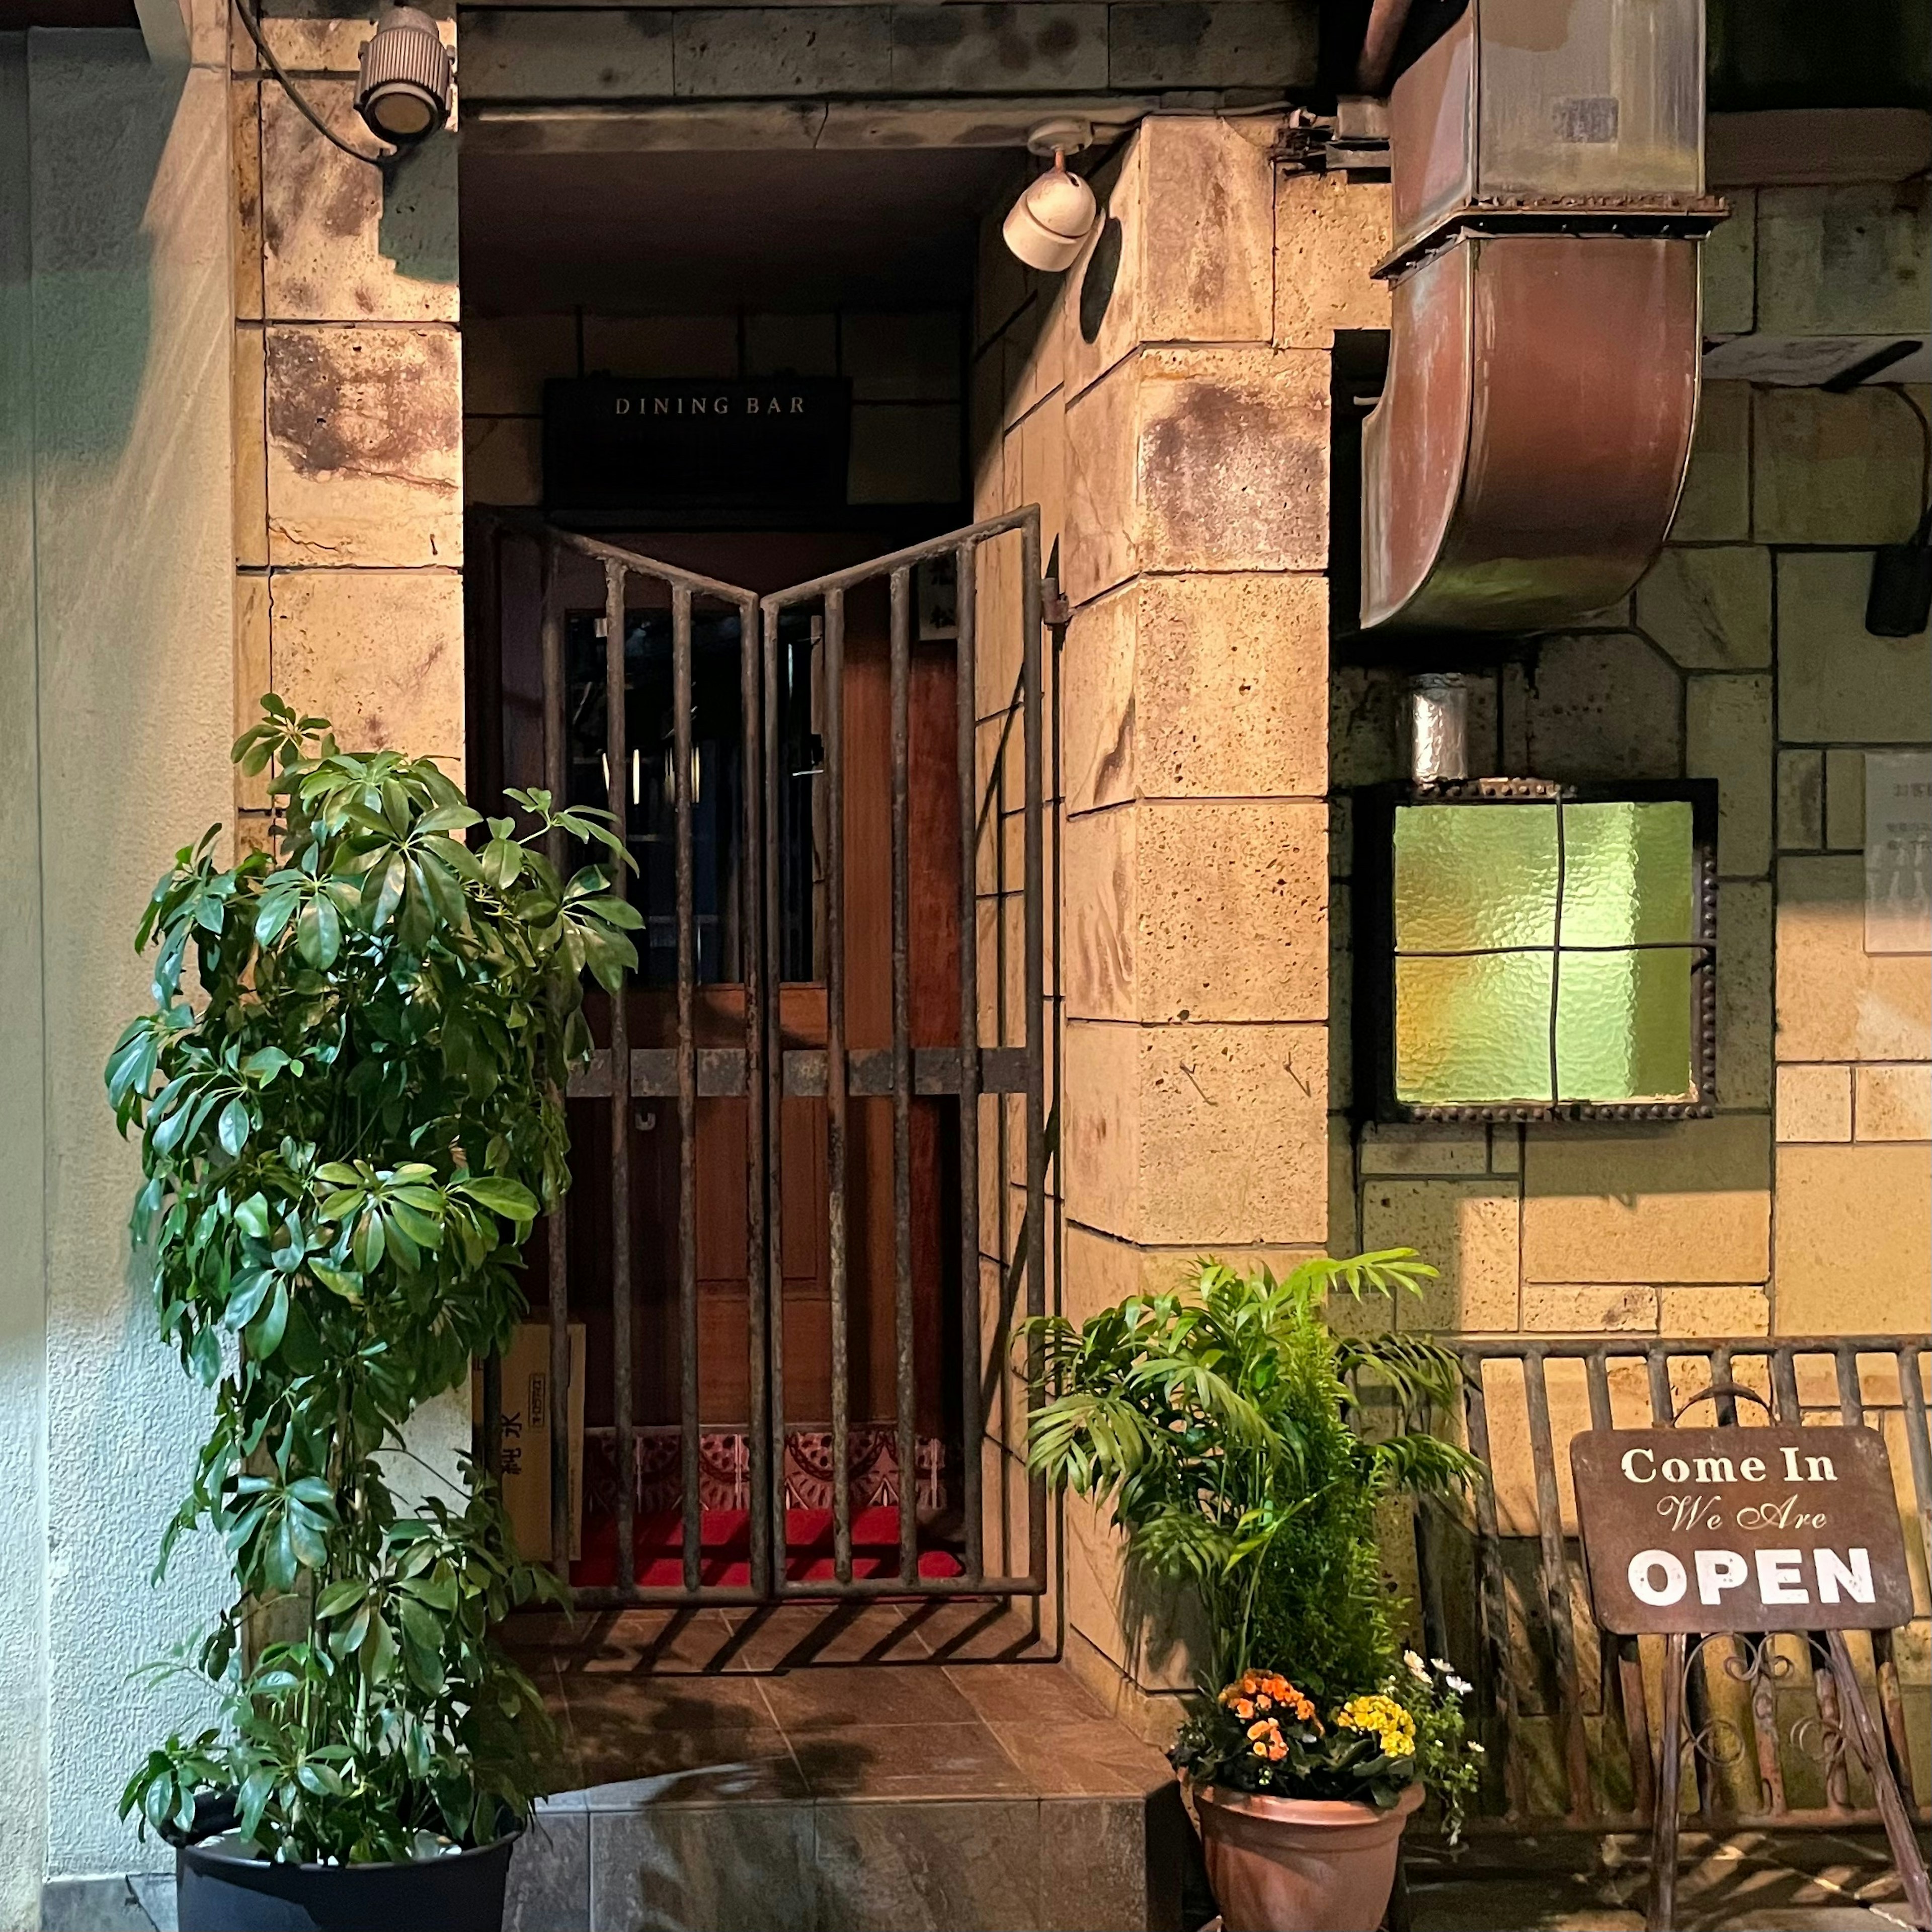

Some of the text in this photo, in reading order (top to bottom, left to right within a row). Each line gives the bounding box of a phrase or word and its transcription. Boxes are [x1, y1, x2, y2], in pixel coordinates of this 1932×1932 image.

[616, 396, 804, 415] DINING BAR
[1621, 1446, 1838, 1483] Come In
[1656, 1494, 1827, 1532] We Are
[1627, 1548, 1876, 1607] OPEN
